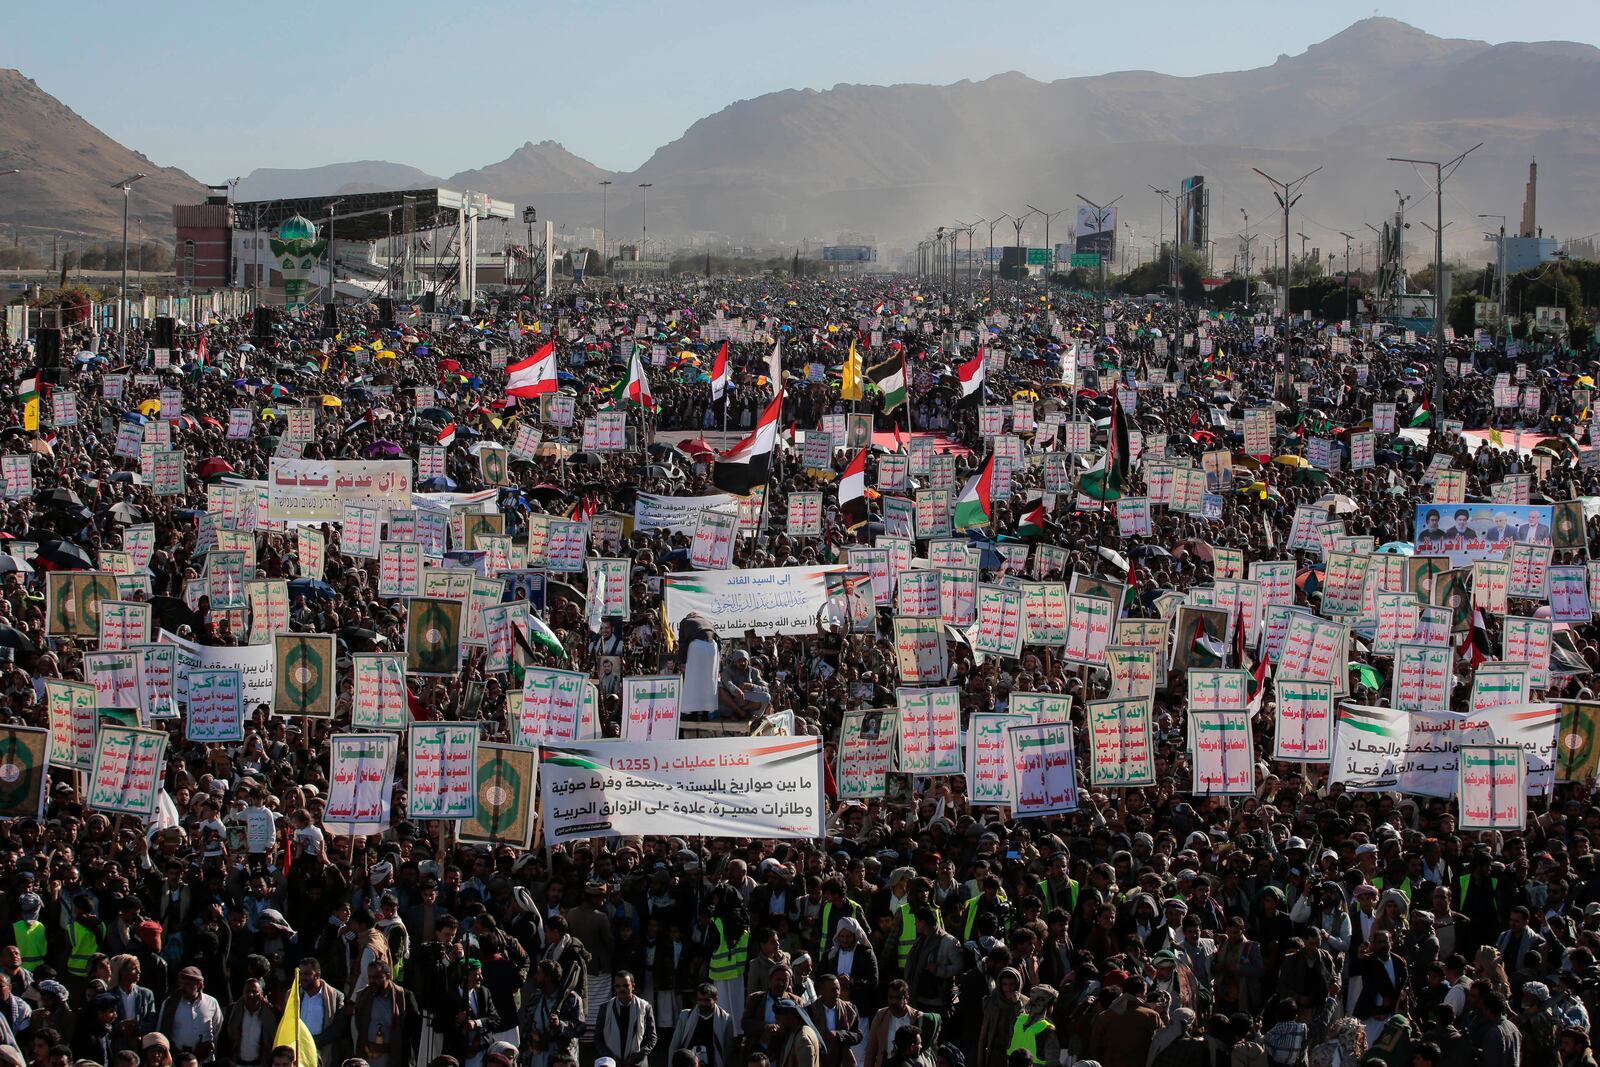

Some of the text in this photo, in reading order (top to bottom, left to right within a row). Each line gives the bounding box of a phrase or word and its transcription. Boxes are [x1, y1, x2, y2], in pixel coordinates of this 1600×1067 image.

[275, 469, 330, 486] عدنا
[335, 472, 373, 492] عدتم
[727, 574, 791, 586] إلى السيد القائد
[1049, 587, 1062, 597] الله
[1005, 594, 1018, 604] الله
[727, 619, 747, 630] مثلما
[748, 618, 774, 629] وجهك
[775, 617, 789, 627] الله
[1430, 652, 1448, 664] الله
[242, 664, 257, 674] يبرز
[259, 660, 269, 673] أن
[219, 677, 236, 688] الله
[559, 677, 578, 692] الله
[936, 694, 955, 706] الله
[932, 712, 955, 723] الموت
[1127, 705, 1145, 718] الله
[933, 726, 956, 737] الموت
[1123, 722, 1146, 734] الموت
[1414, 719, 1489, 735] جبهة الإسناد
[140, 736, 160, 748] الله
[451, 731, 471, 744] الله
[1124, 737, 1147, 749] الموت
[938, 740, 956, 751] اللعنة
[1348, 736, 1557, 757] في والحكمة والجهاد
[133, 751, 157, 763] الموت
[447, 750, 470, 761] الموت
[720, 754, 750, 767] نفذنا
[1130, 752, 1148, 762] اللعنة
[672, 755, 716, 771] عمليات
[933, 755, 957, 771] النصر
[1381, 762, 1414, 777] العالم
[1416, 763, 1438, 773] به
[131, 765, 154, 777] الموت
[447, 766, 470, 778] الموت
[1126, 764, 1149, 781] النصر
[133, 779, 152, 790] اللعنة
[451, 782, 470, 792] اللعنة
[552, 780, 586, 796] صوتية
[590, 775, 622, 791] وفرط
[729, 777, 773, 794] صواريخ
[776, 779, 797, 792] بين
[800, 776, 812, 789] ما
[125, 793, 150, 808] النصر
[445, 795, 471, 813] النصر
[645, 800, 669, 814] على
[553, 802, 596, 820] الحربية
[599, 800, 641, 816] الزوارق
[673, 801, 706, 815] علاوة
[761, 802, 813, 817] وطائرات
